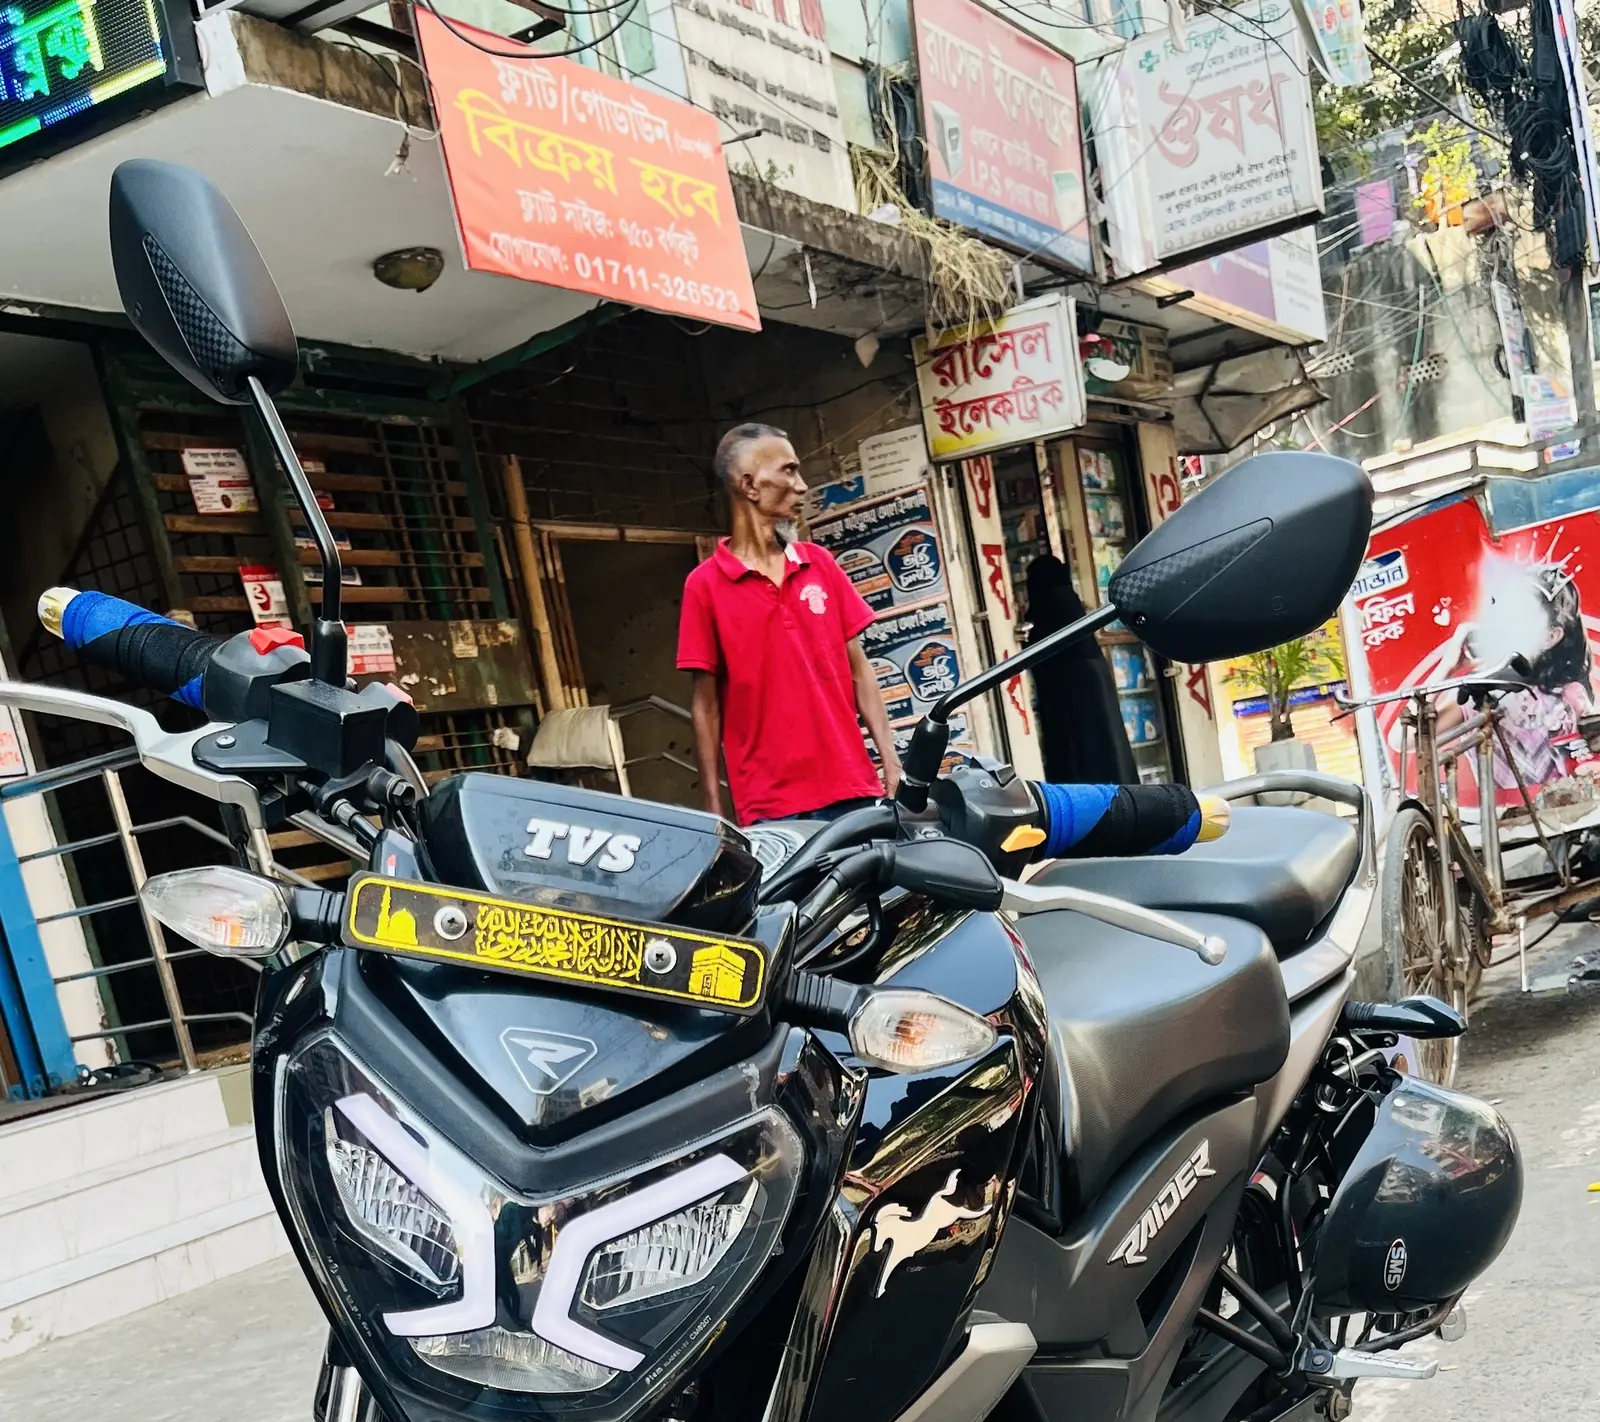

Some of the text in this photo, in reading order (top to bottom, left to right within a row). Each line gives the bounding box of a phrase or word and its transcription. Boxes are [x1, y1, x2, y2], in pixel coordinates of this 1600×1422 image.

[921, 19, 986, 104] রাসেল
[1151, 72, 1292, 169] ঔষধ
[455, 87, 618, 197] বিক্রয়
[628, 157, 721, 227] হবে
[575, 252, 741, 313] 01711-326523
[927, 322, 1052, 388] রাসেল
[933, 375, 1063, 440] ইলেকট্রিক
[524, 817, 642, 873] TVS
[1107, 1138, 1217, 1266] RAIDER
[1387, 1246, 1406, 1285] SMS
